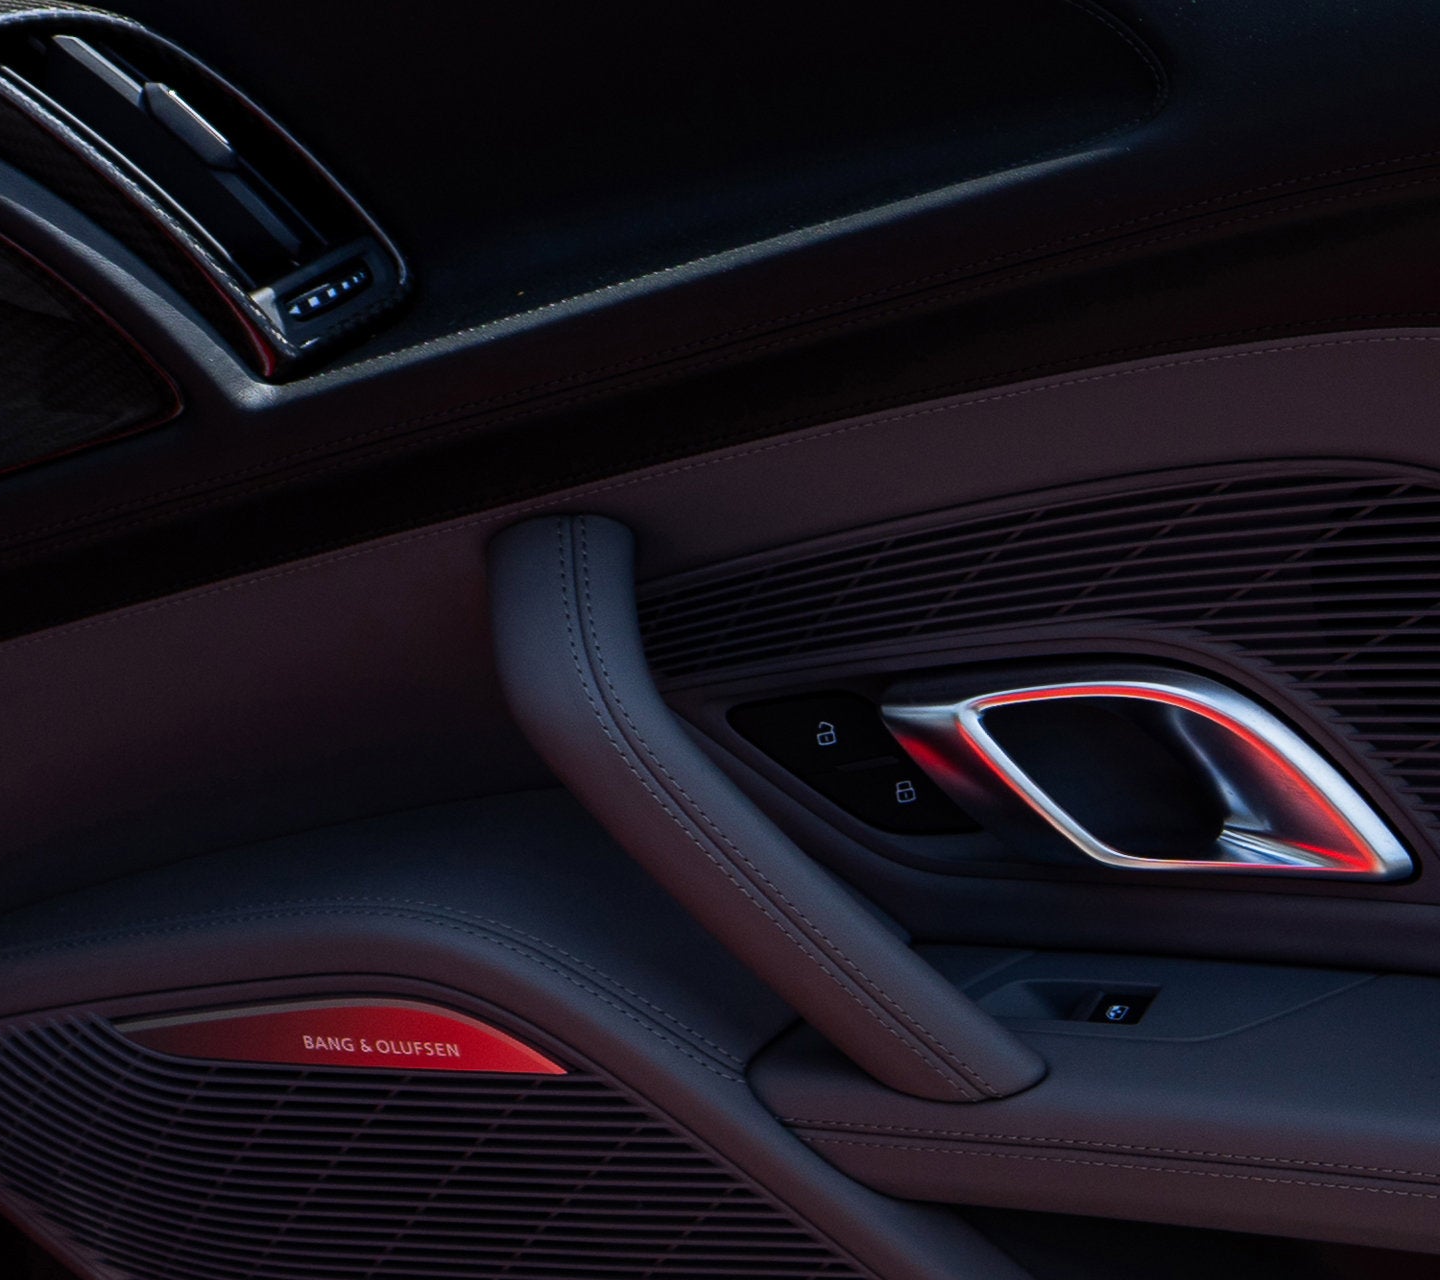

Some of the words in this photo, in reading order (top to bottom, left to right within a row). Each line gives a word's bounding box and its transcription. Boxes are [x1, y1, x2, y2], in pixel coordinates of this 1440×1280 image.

[302, 1034, 355, 1053] BANG
[360, 1038, 373, 1053] &
[375, 1039, 461, 1058] OLUFSEN
